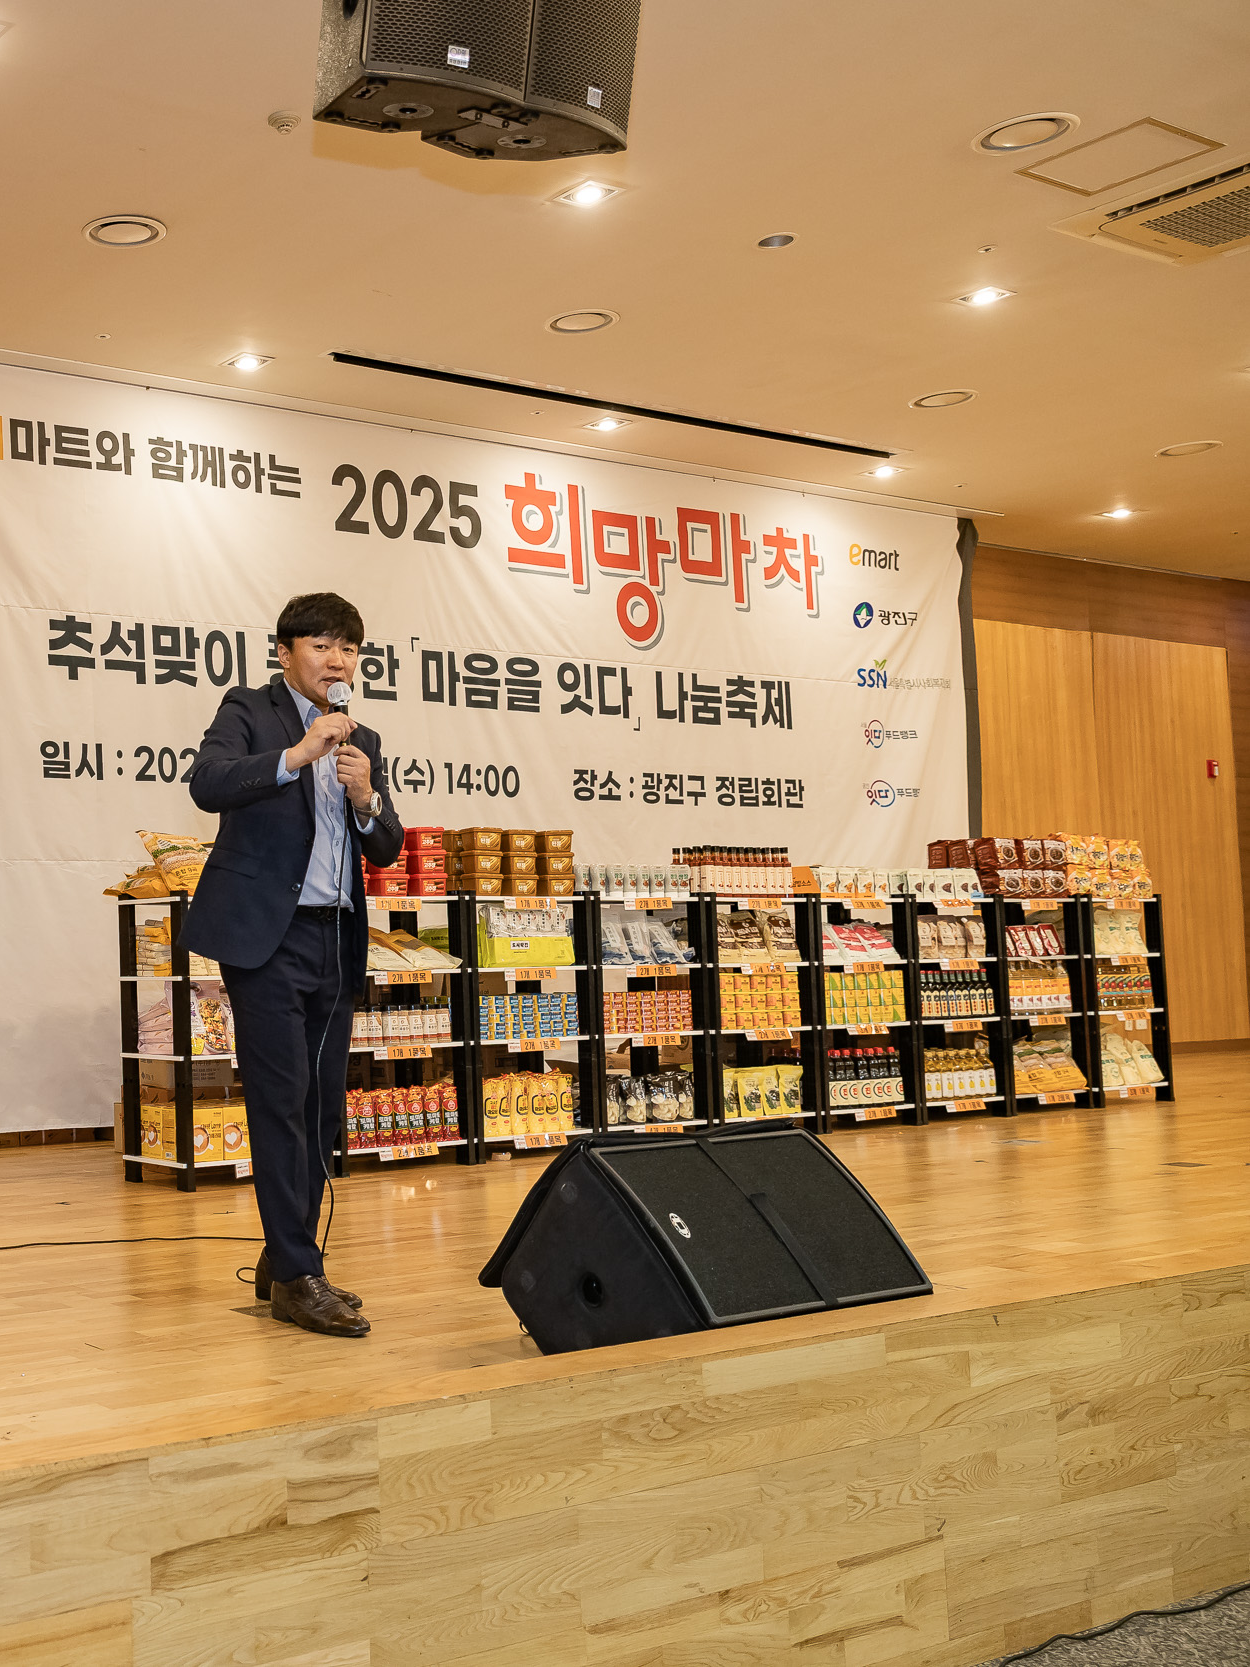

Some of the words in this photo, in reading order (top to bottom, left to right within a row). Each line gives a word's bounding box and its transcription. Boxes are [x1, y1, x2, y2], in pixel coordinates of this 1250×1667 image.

[148, 436, 302, 499] 함께하는
[330, 464, 482, 549] 2025
[504, 471, 820, 645] 희망마차
[849, 543, 900, 571] emart
[878, 610, 918, 626] 광진구
[48, 615, 247, 688] 추석맞이
[655, 671, 793, 730] 나눔축제
[857, 667, 888, 689] SSN
[885, 730, 918, 740] 푸드뱅크
[39, 741, 105, 781] 일시
[133, 745, 197, 784] 202
[382, 756, 435, 794] (수)
[444, 762, 520, 798] 14:00
[572, 769, 622, 802] 장소
[642, 772, 708, 806] 광진구
[714, 773, 804, 808] 정립회관
[896, 788, 920, 798] 푸드뱅
[392, 974, 403, 982] 2개
[408, 972, 426, 982] 1품목
[520, 971, 530, 979] 1개
[535, 970, 552, 979] 1품목
[525, 1042, 535, 1050] 2개
[540, 1040, 555, 1049] 1품목
[661, 1036, 676, 1044] 1품목
[393, 1049, 403, 1057] 1개
